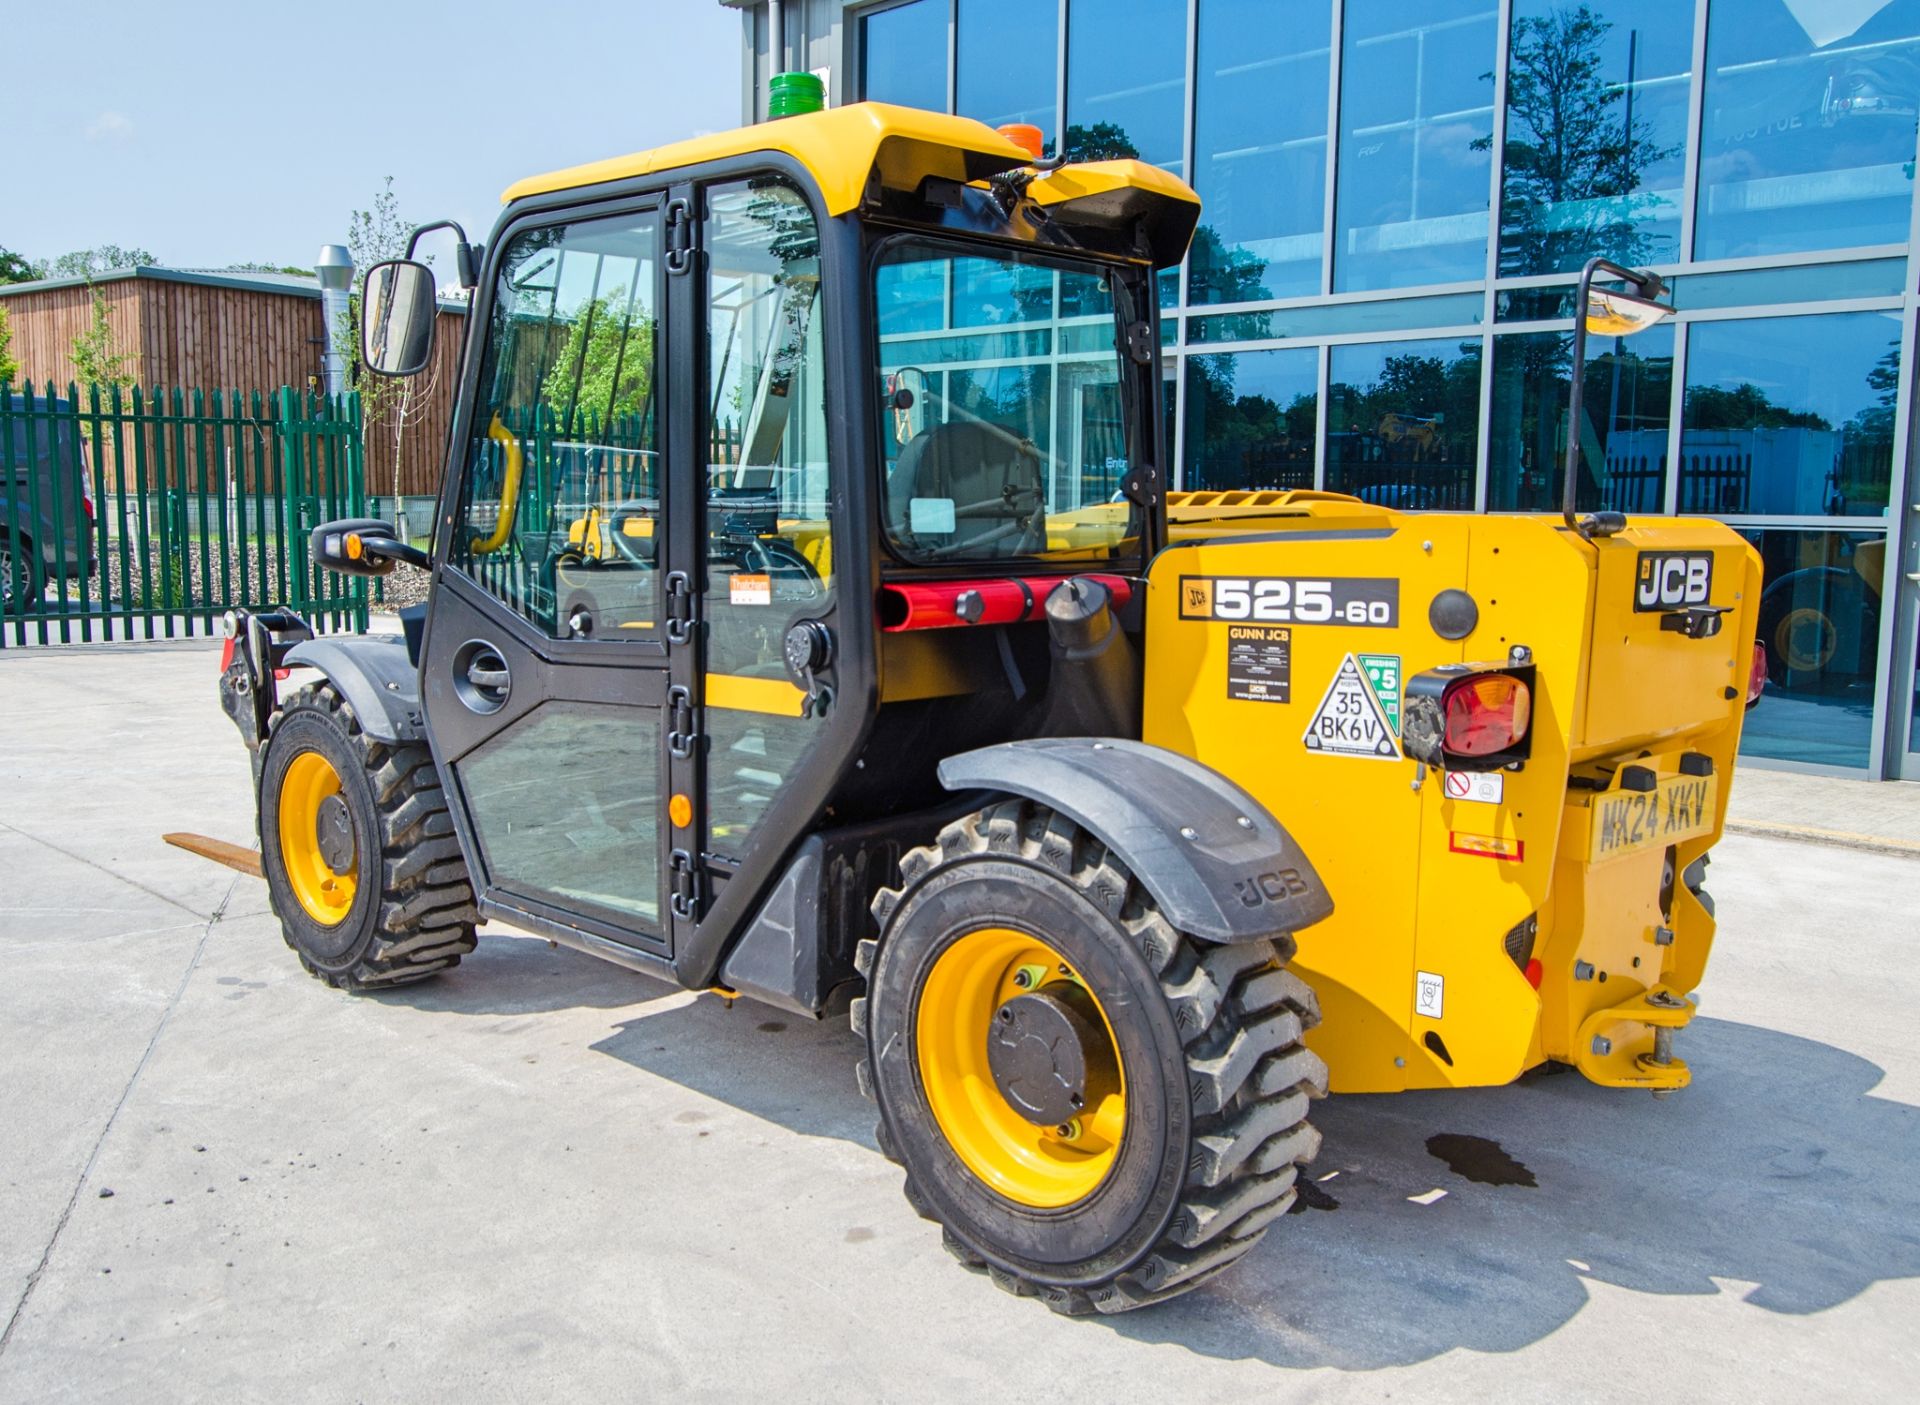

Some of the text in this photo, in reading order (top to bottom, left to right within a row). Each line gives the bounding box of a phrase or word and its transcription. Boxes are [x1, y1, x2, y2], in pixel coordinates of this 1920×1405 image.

[1639, 557, 1710, 606] JCB
[1189, 588, 1207, 607] JCB
[1230, 627, 1289, 641] GUNN JCB
[1381, 668, 1397, 690] 5
[1336, 691, 1362, 716] 35
[1321, 716, 1376, 742] BK6V
[1600, 780, 1708, 852] MK24 XKV
[1233, 867, 1309, 908] JCB
